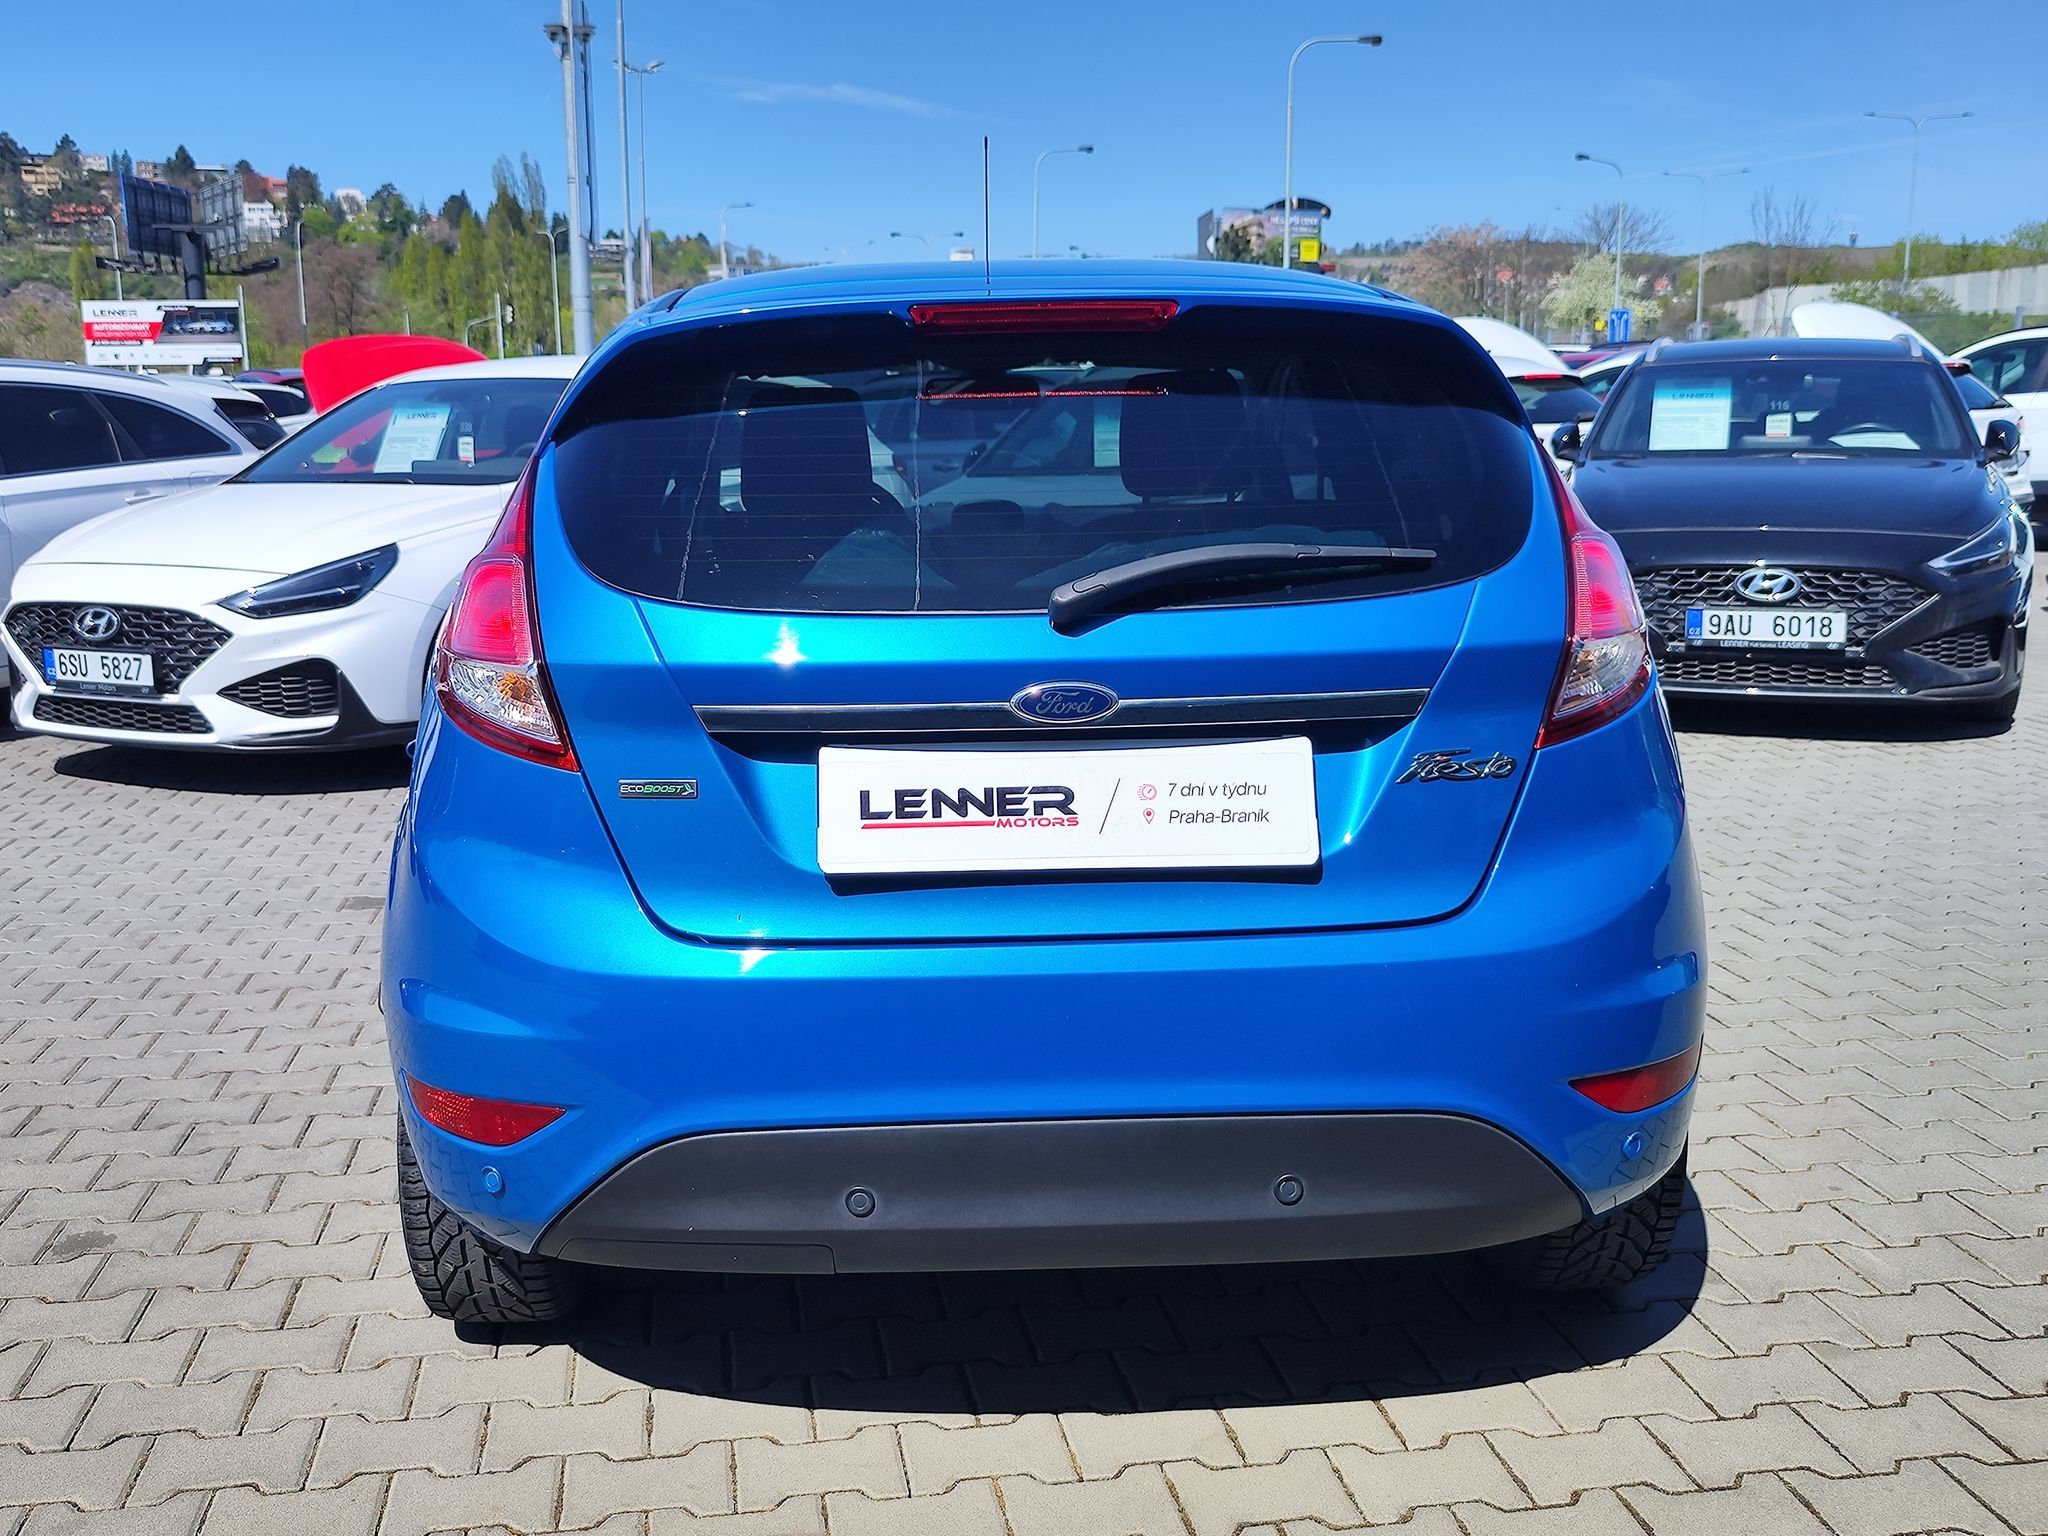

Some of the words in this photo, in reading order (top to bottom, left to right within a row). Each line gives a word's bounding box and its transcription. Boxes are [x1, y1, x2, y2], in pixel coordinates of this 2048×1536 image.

[1709, 614, 1753, 636] 9AU
[1773, 615, 1833, 638] 6018
[58, 652, 89, 678] 6SU
[100, 655, 142, 681] 5827
[1035, 690, 1095, 715] Ford
[1168, 782, 1178, 797] 7
[1180, 782, 1206, 797] dní
[1208, 785, 1218, 796] v
[1222, 781, 1267, 799] týdnu
[859, 785, 1078, 820] LENNER
[996, 816, 1079, 828] MOTORS
[1168, 808, 1270, 824] Praha-Braník
